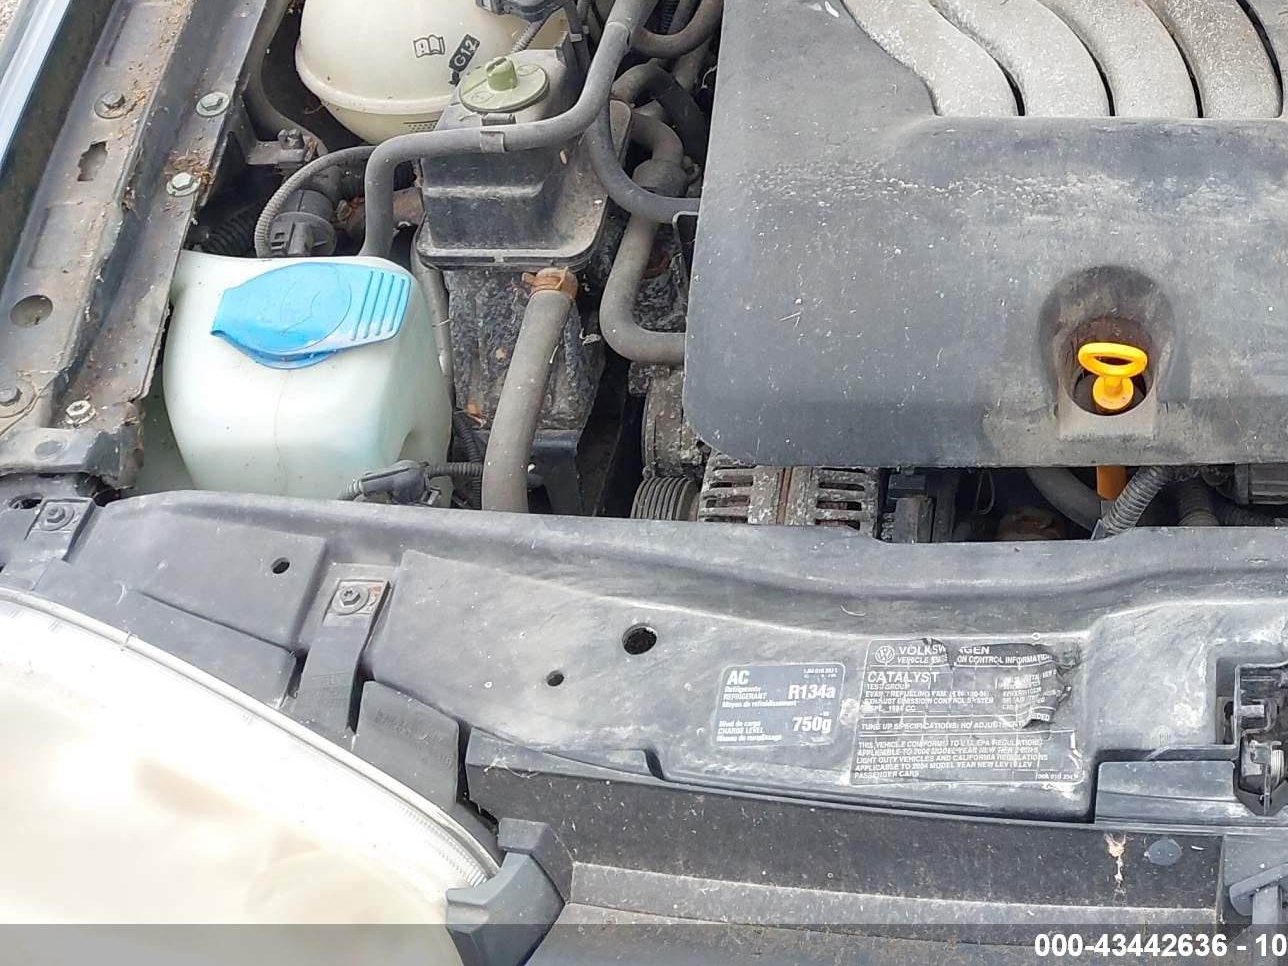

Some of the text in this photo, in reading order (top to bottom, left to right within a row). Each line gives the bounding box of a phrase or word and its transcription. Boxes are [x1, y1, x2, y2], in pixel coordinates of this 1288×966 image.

[454, 40, 478, 66] G12
[897, 656, 929, 664] VEHICLE
[968, 656, 1003, 664] CONTROL
[727, 670, 750, 685] AC
[867, 671, 940, 683] CATALYST
[788, 684, 836, 699] R134a
[792, 716, 832, 734] 750g
[855, 771, 897, 779] PASSENGER
